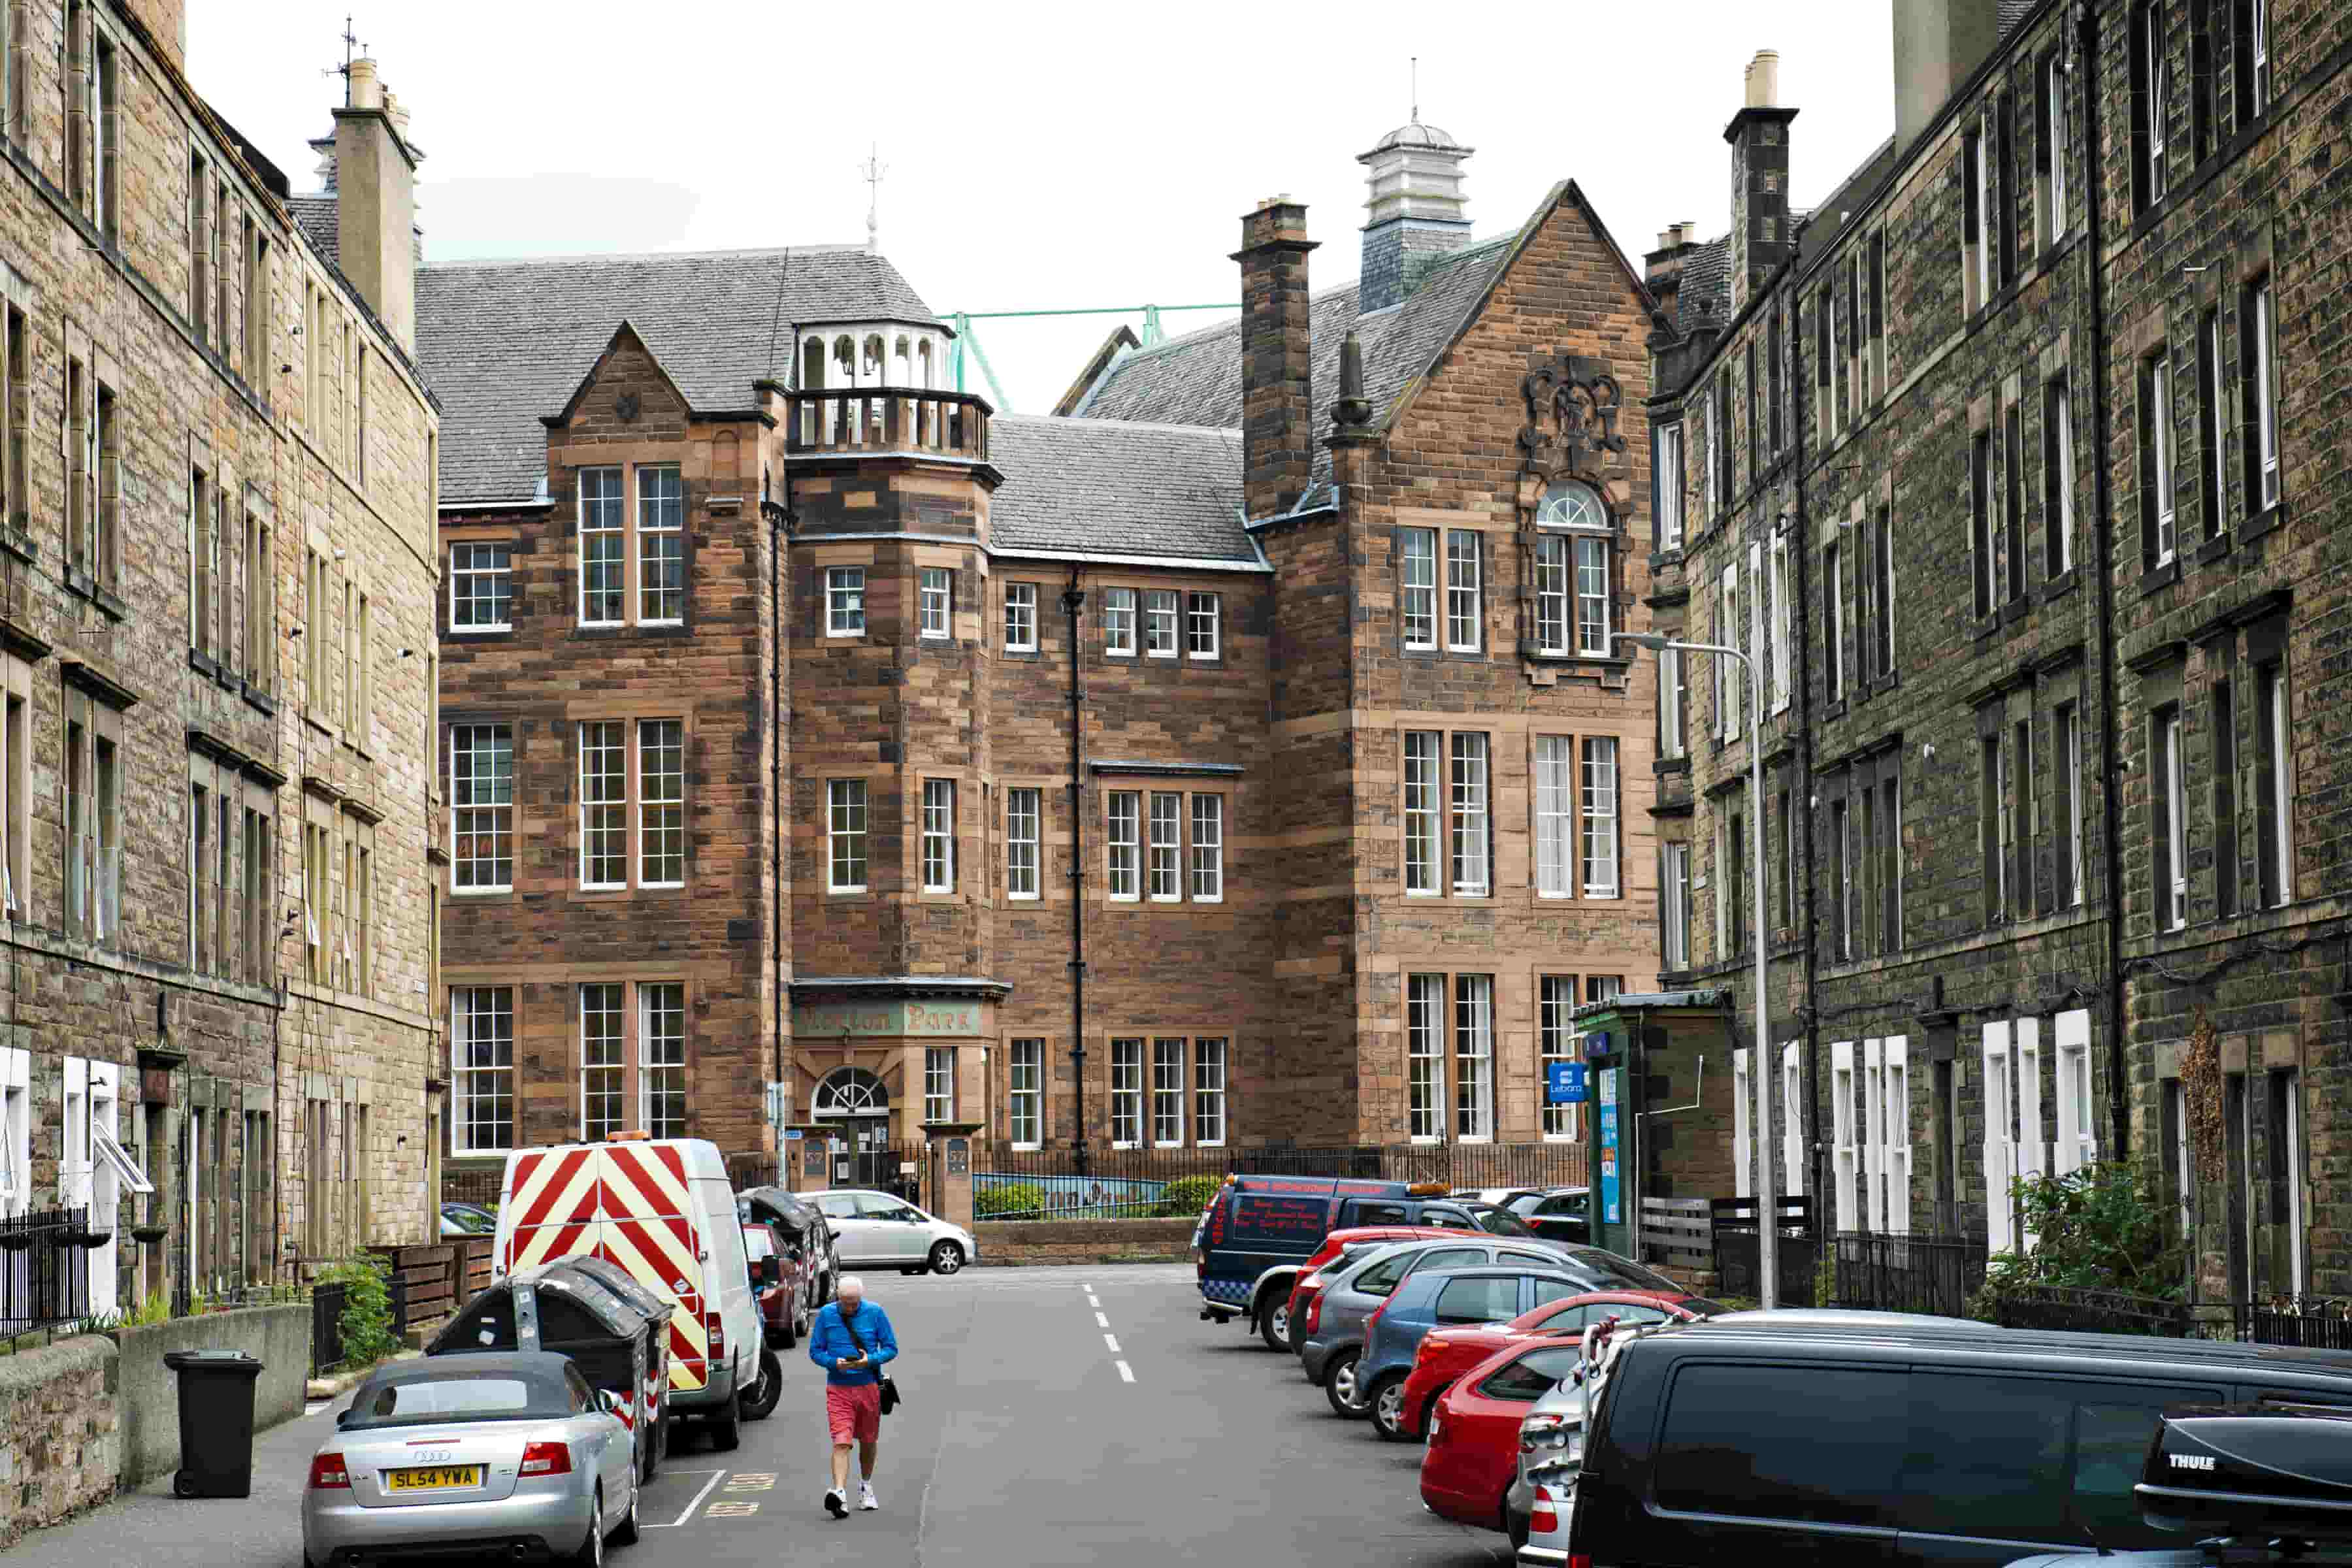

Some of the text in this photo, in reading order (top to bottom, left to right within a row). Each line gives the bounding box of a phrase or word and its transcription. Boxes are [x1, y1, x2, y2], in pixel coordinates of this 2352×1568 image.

[2169, 1453, 2216, 1471] THULE
[397, 1467, 472, 1488] SL54 YWA
